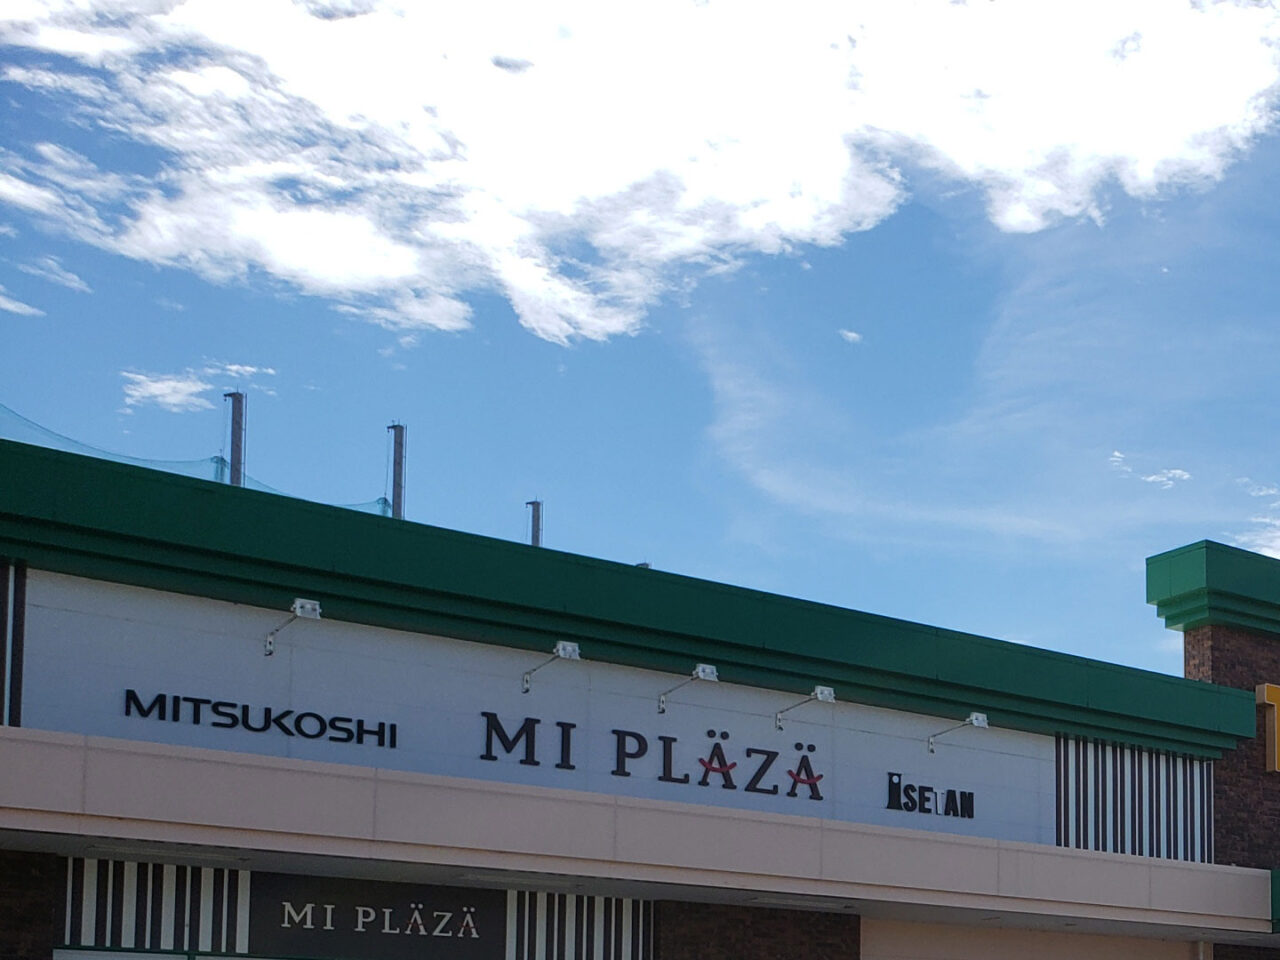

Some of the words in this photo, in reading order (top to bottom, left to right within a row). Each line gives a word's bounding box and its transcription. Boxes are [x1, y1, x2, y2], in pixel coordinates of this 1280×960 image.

[124, 688, 398, 749] MITSUKOSHI
[479, 711, 578, 771] MI
[610, 728, 825, 801] PLÄZÄ
[885, 771, 975, 819] ISETAN
[281, 901, 335, 930] MI
[354, 903, 480, 938] PLÄZÄ
